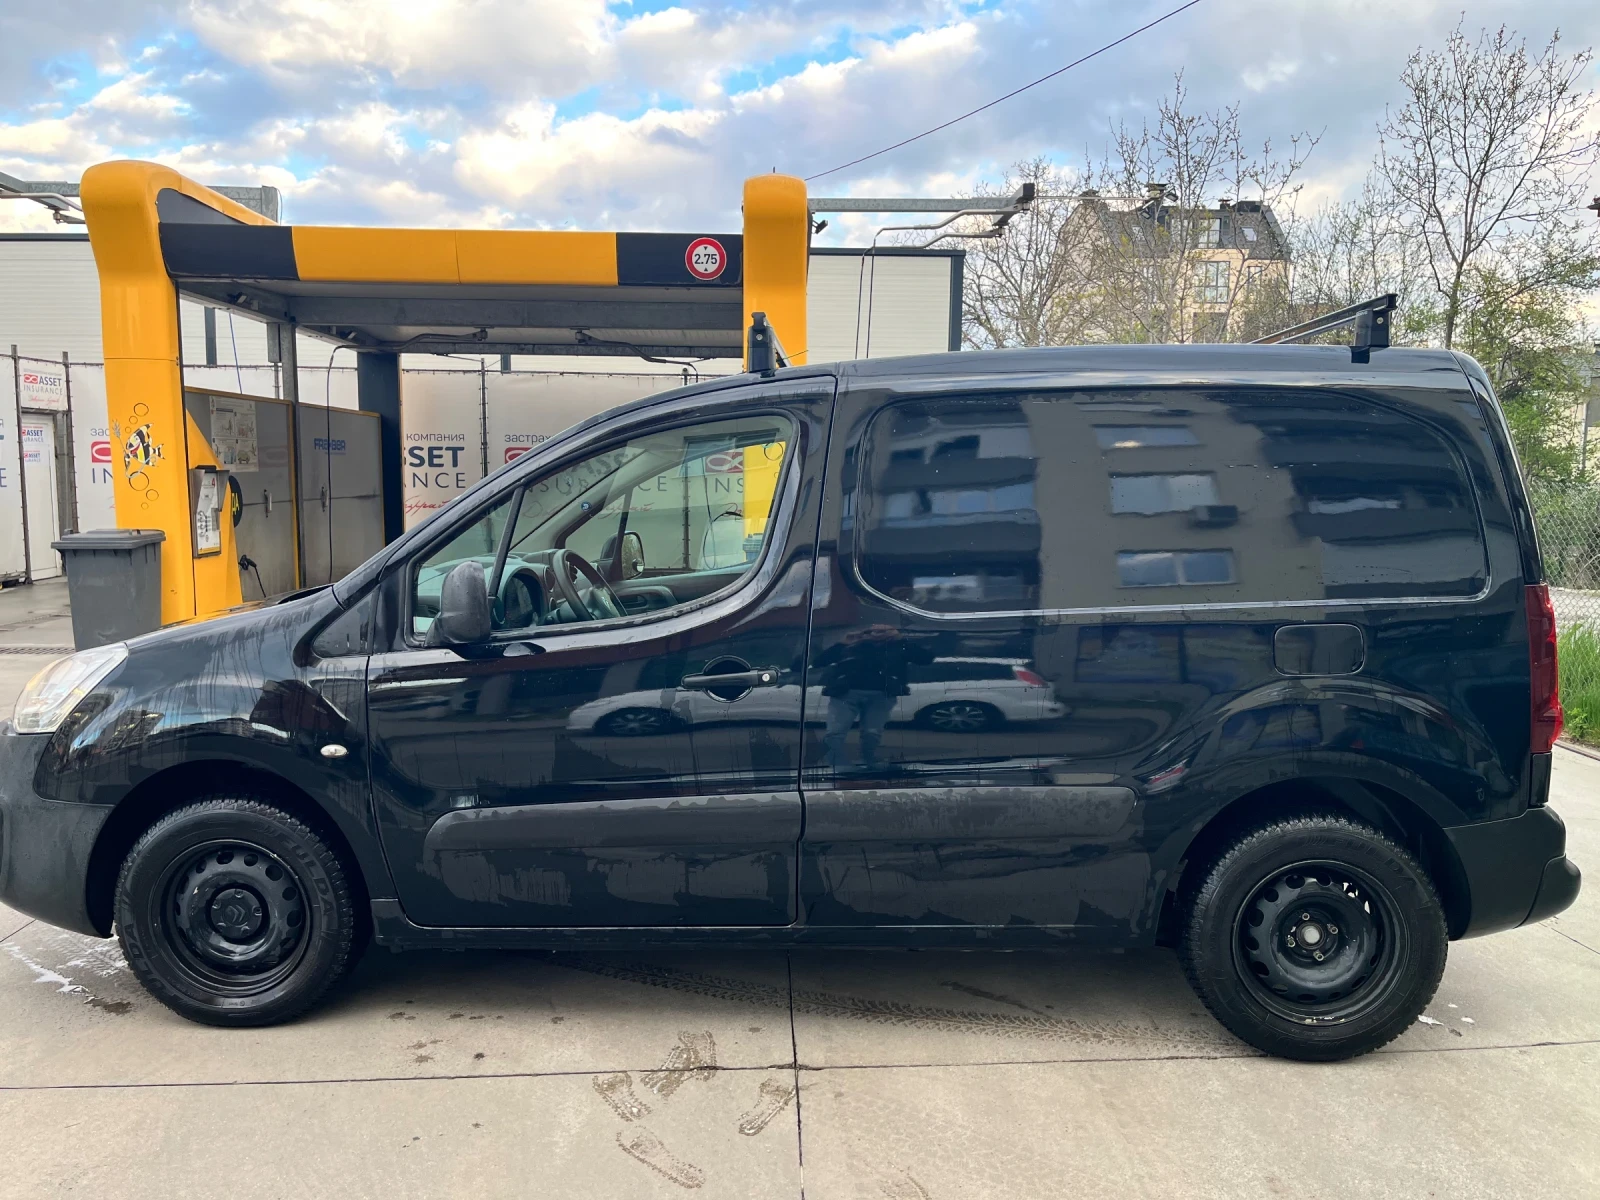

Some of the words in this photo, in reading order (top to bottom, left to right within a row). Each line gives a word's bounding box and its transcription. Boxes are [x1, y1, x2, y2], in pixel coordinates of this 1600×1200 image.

[694, 253, 718, 265] 2.75
[39, 376, 62, 387] ASSET
[23, 384, 63, 396] INSURANCE
[406, 433, 465, 442] компания
[404, 445, 465, 468] SET
[404, 472, 467, 489] NCE
